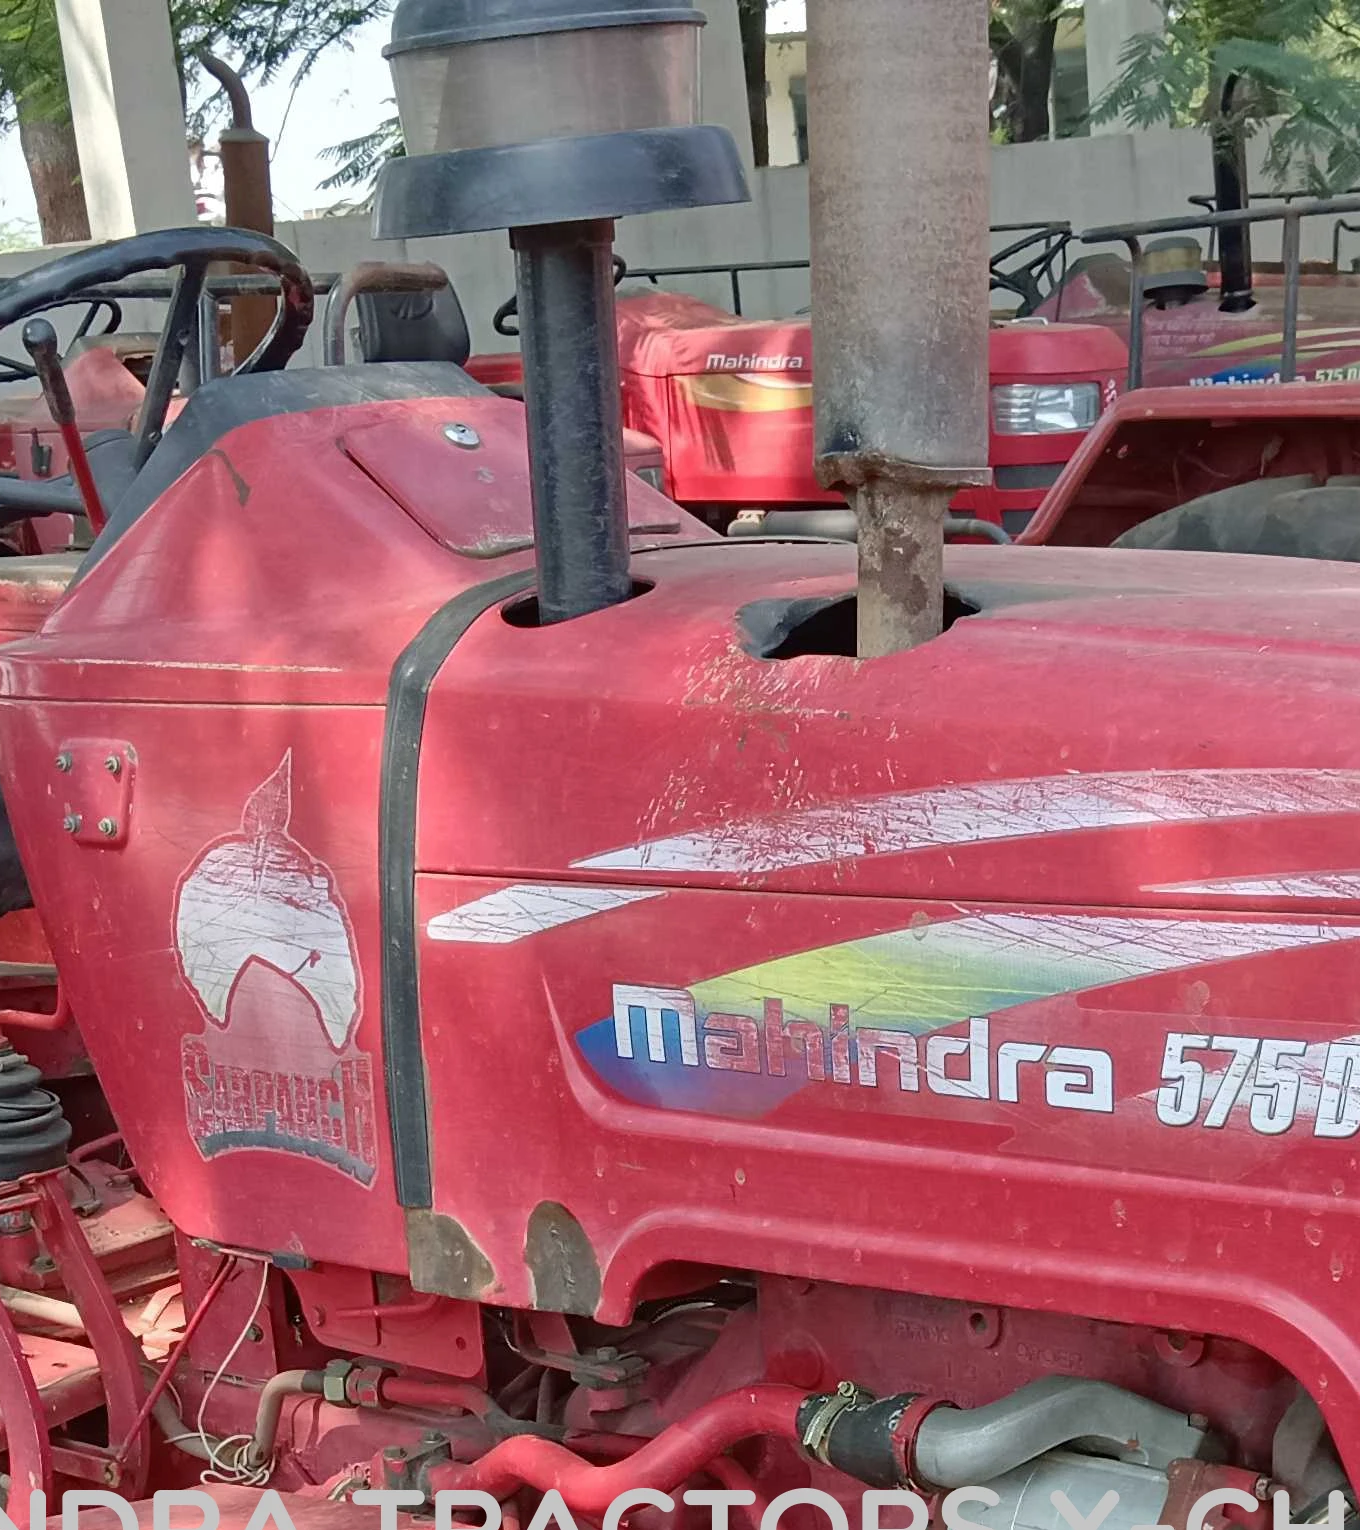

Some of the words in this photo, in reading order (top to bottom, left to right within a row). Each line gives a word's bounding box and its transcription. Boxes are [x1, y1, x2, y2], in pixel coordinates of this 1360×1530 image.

[706, 354, 803, 369] Mahindra
[612, 983, 1114, 1112] Mahindra
[1157, 1031, 1307, 1138] 575
